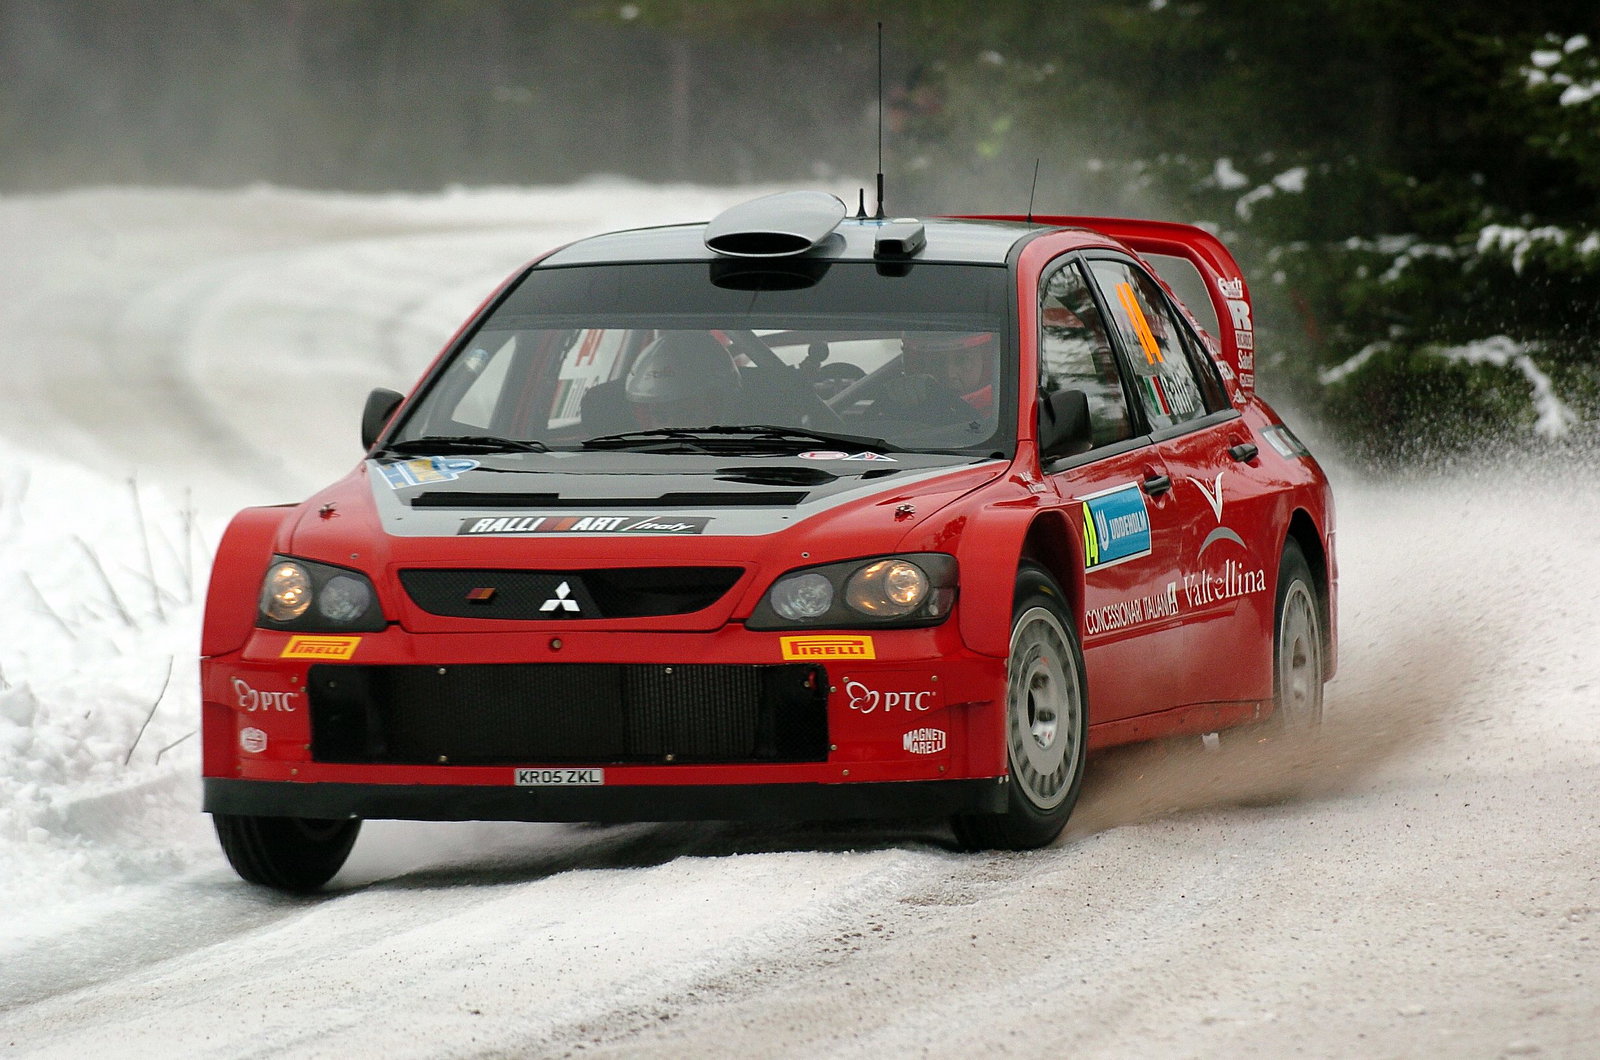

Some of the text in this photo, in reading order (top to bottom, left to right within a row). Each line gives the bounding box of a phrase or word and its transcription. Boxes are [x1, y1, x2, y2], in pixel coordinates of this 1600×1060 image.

[1115, 282, 1164, 365] 14
[469, 517, 547, 532] RALLI
[570, 516, 630, 532] ART
[1184, 558, 1266, 608] Valtellina
[289, 640, 352, 655] PIRELLI
[790, 640, 865, 655] PIRELLI
[260, 691, 297, 712] PTC
[884, 691, 931, 712] PTC
[903, 728, 946, 742] MAGNETI
[903, 740, 946, 754] MARELLI
[519, 771, 600, 783] KR05 ZKL
